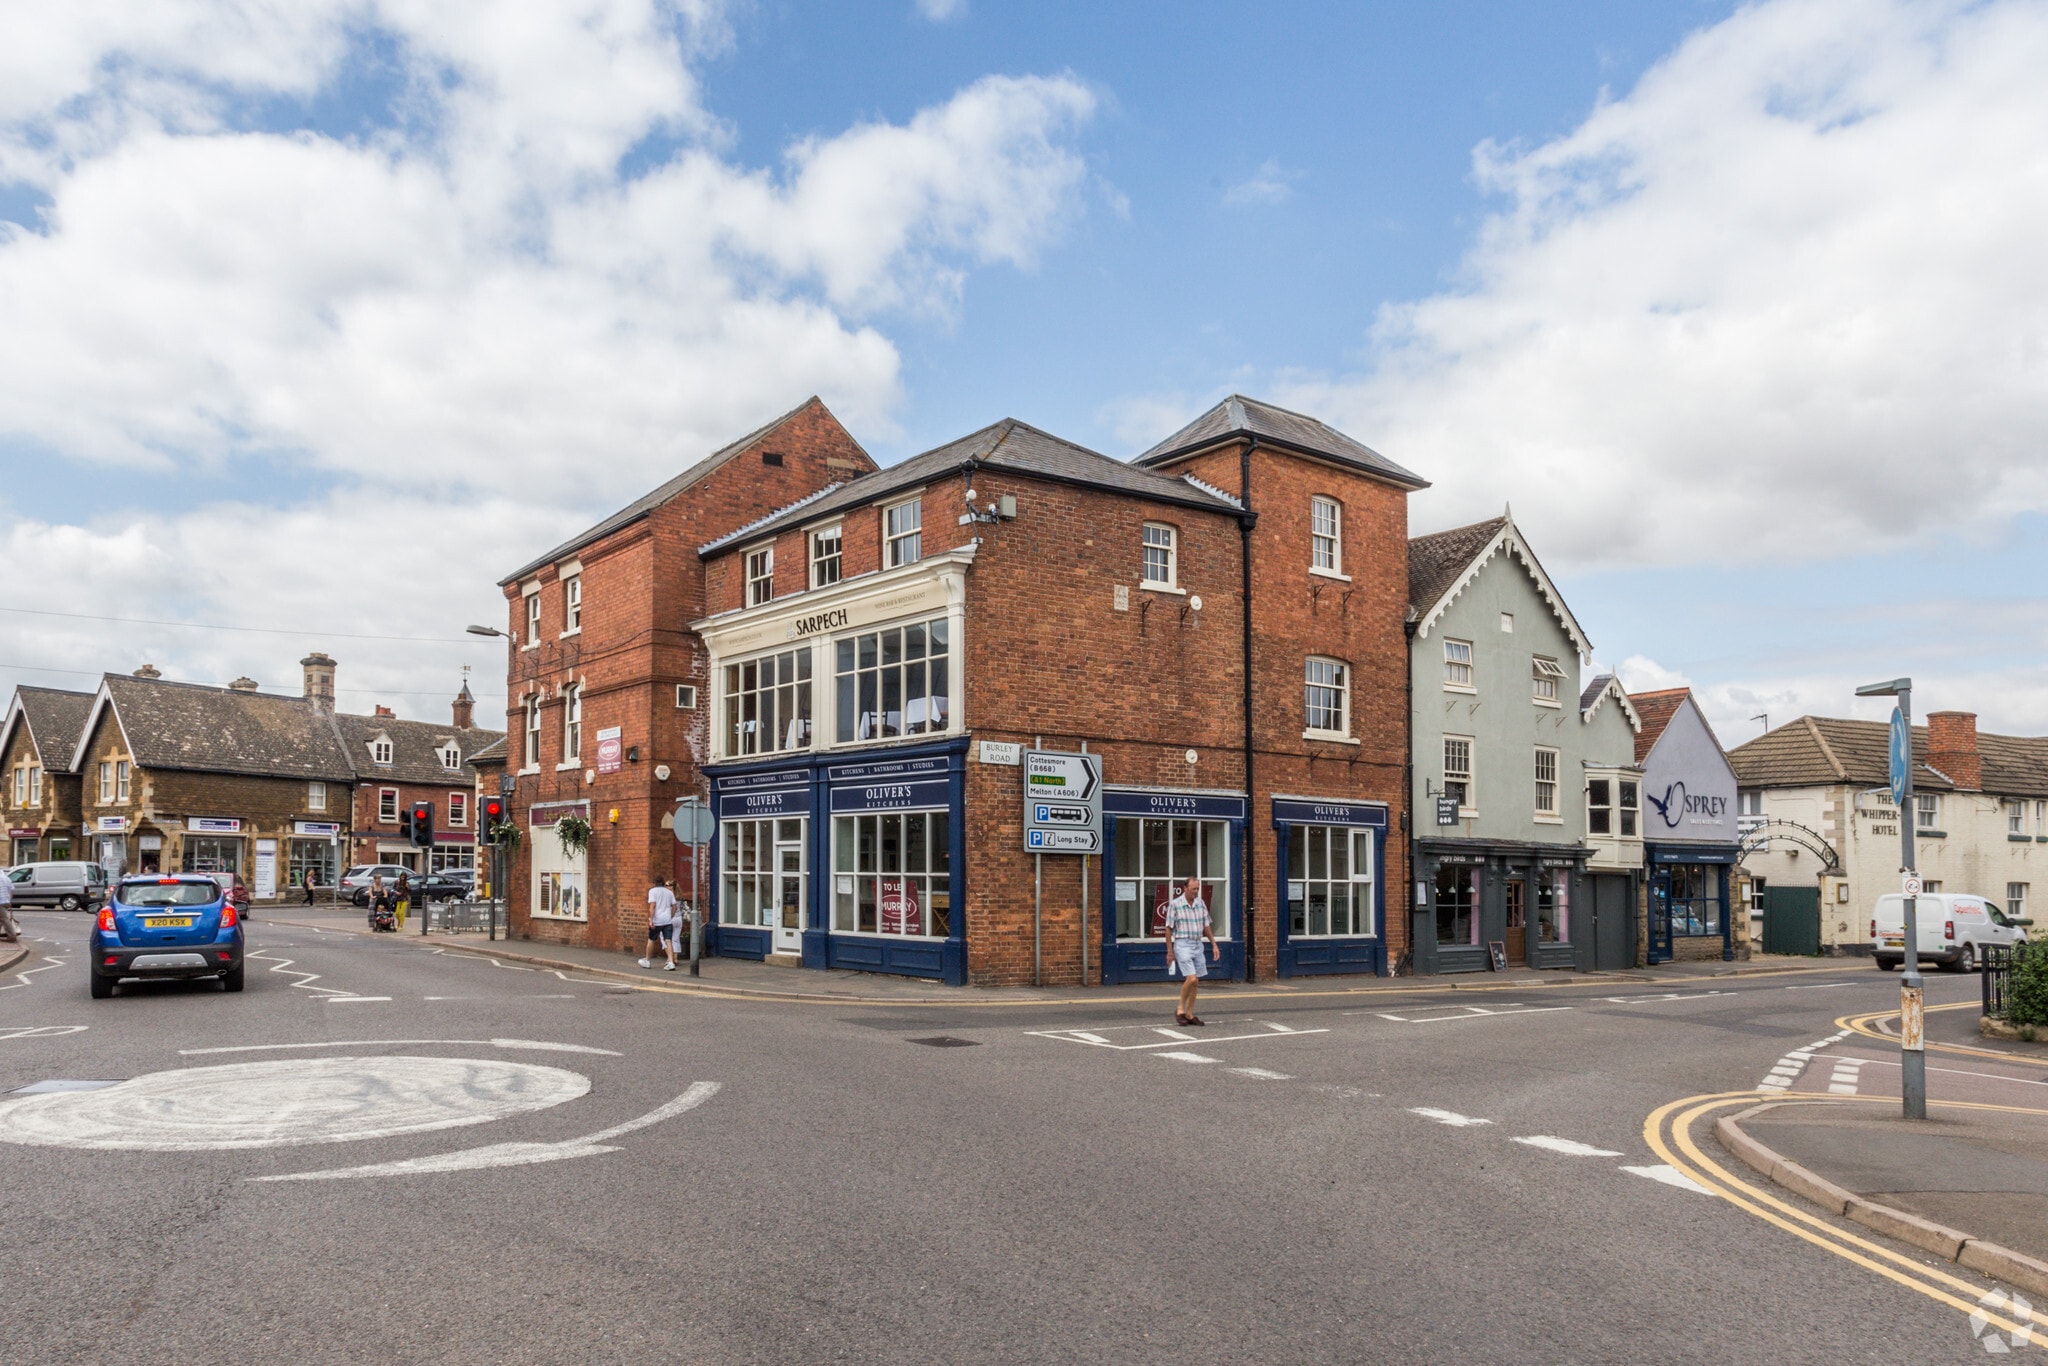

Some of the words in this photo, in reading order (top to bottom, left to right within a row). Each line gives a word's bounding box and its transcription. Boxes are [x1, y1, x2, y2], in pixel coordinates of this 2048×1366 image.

[796, 609, 849, 636] SARPECH
[986, 743, 1013, 753] BURLEY
[990, 753, 1011, 763] ROAD
[1030, 756, 1067, 766] Cottesmore
[841, 767, 865, 776] KITCHENS
[873, 764, 904, 773] BATHROOMS
[912, 761, 935, 769] STUDIES
[1044, 775, 1066, 785] North)
[866, 785, 912, 799] OLIVER'S
[1030, 788, 1052, 796] Melton
[1053, 788, 1080, 798] (A606)
[746, 794, 783, 807] OLIVER'S
[866, 799, 911, 808] KITCHENS
[1150, 797, 1197, 808] OLIVER'S
[1665, 781, 1728, 828] OSPREY
[1877, 794, 1893, 805] THE
[1314, 806, 1350, 816] OLIVER'S
[1872, 825, 1898, 836] HOTEL
[1057, 836, 1073, 844] Long
[1074, 835, 1088, 844] Stay
[883, 883, 892, 891] TO
[169, 918, 186, 926] KSX
